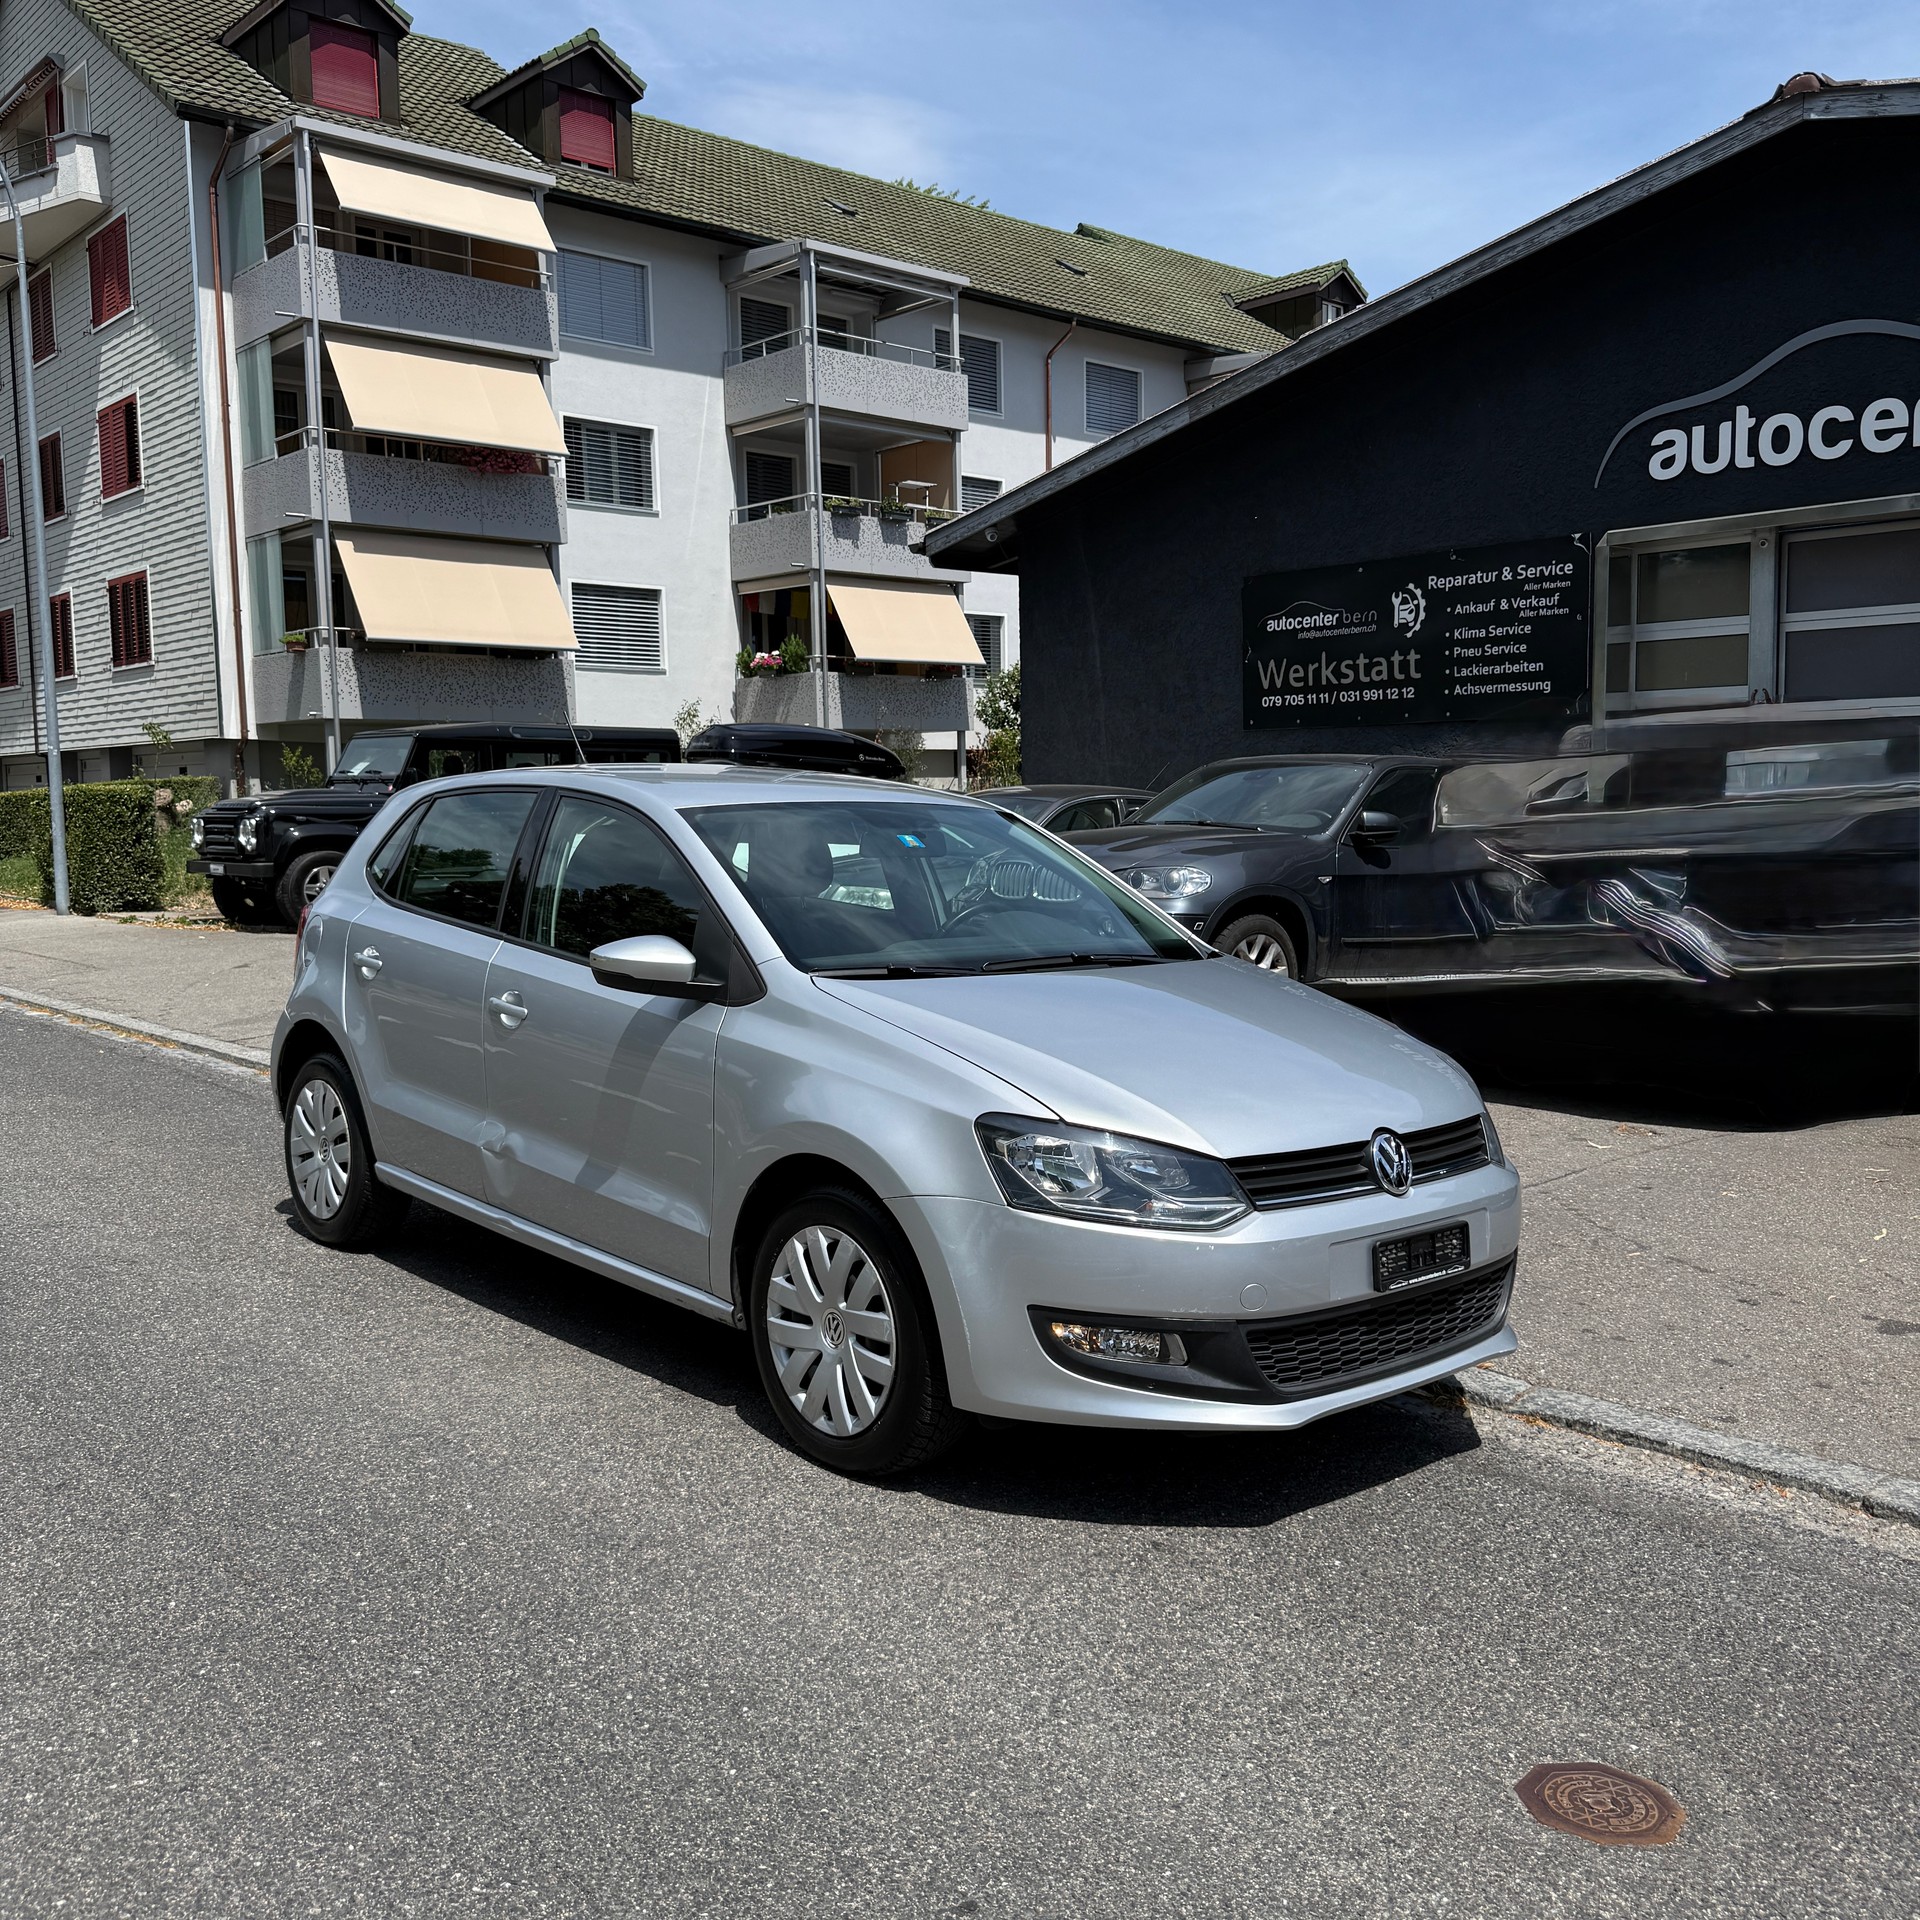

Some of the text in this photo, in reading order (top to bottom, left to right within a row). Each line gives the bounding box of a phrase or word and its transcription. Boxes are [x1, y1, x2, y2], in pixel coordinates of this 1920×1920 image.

[1648, 397, 1920, 481] autoce
[1428, 560, 1574, 592] Reparatur & Service
[1523, 580, 1571, 591] Aller Marken
[1454, 592, 1560, 615] Ankauf & Verkauf
[1519, 606, 1569, 618] Aller Marken
[1266, 609, 1378, 632] autocenter bern
[1297, 624, 1377, 640] info@autocenterbern.ch
[1454, 622, 1532, 640] Klima Service
[1453, 641, 1527, 658] Pneu Service
[1257, 648, 1422, 690] Werkstatt
[1454, 660, 1544, 677] Lackierarbeiten
[1261, 687, 1415, 707] 079 705 11 11 / 031 991 12 12
[1453, 680, 1551, 696] Achsvermessung
